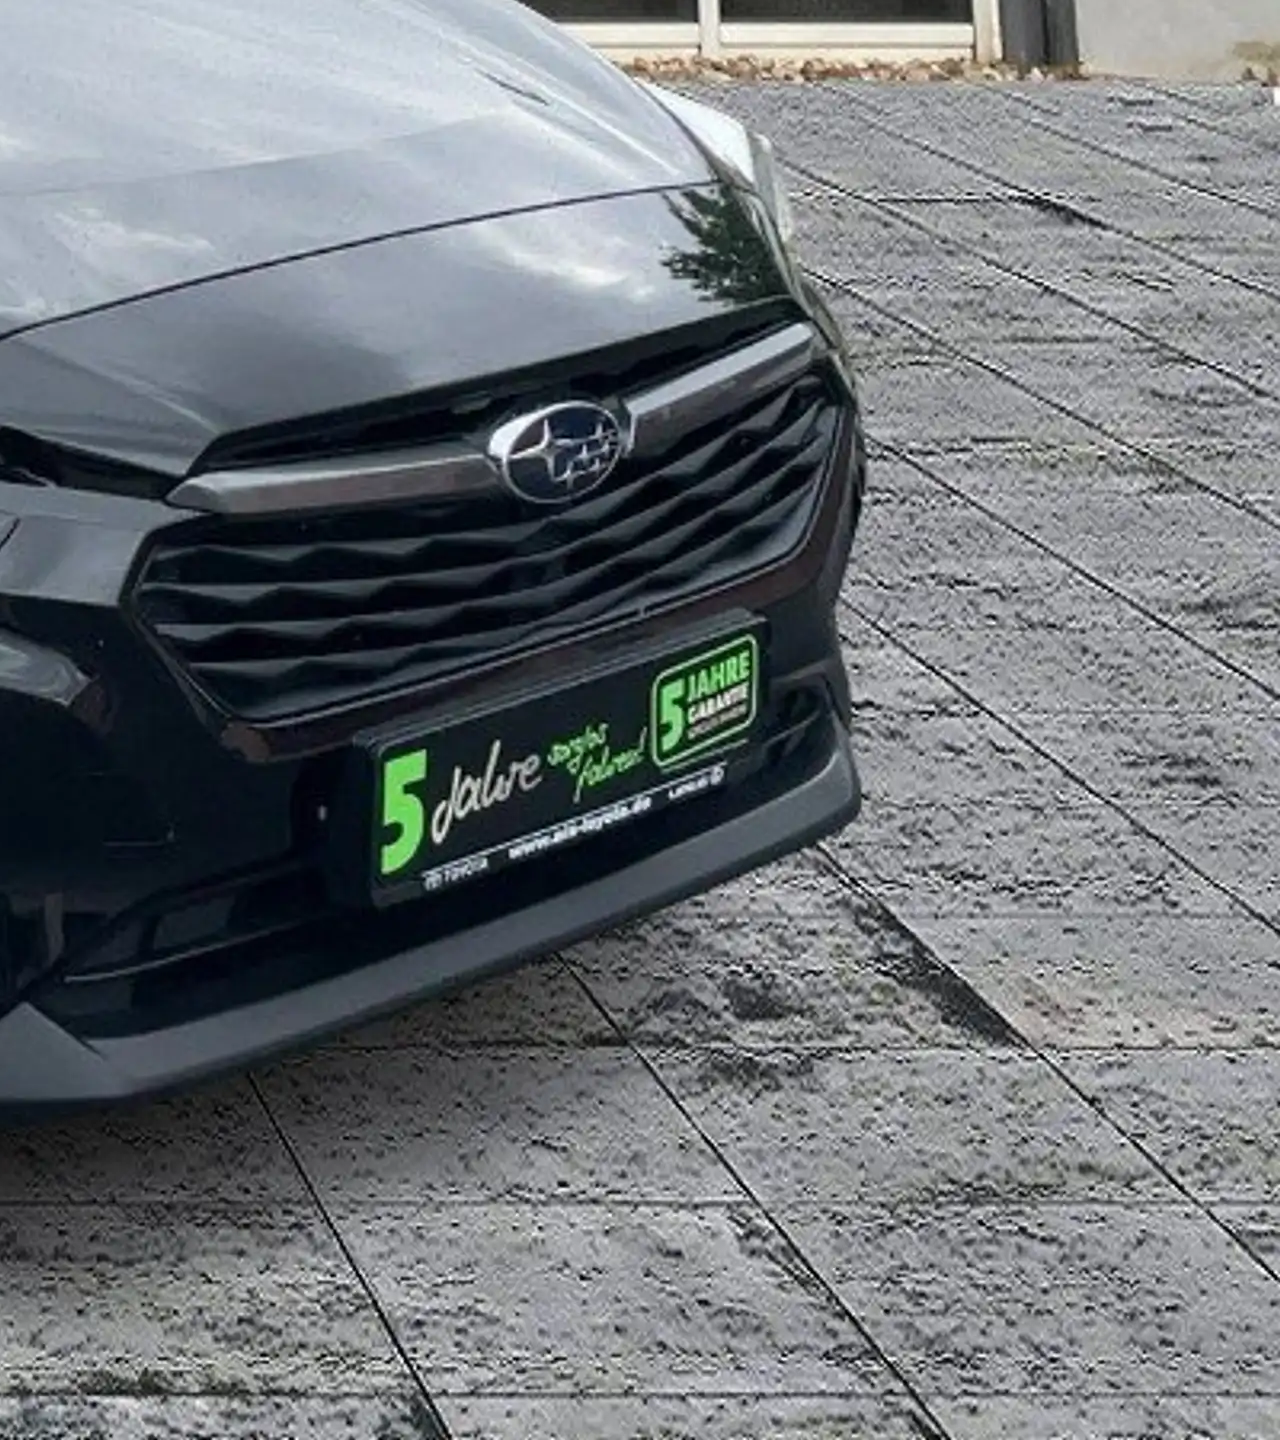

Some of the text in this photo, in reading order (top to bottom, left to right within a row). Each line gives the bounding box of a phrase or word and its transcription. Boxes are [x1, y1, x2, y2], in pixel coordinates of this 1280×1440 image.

[660, 678, 686, 753] 5
[687, 649, 751, 703] JAHRE
[381, 749, 428, 875] 5
[431, 739, 542, 844] Jahre
